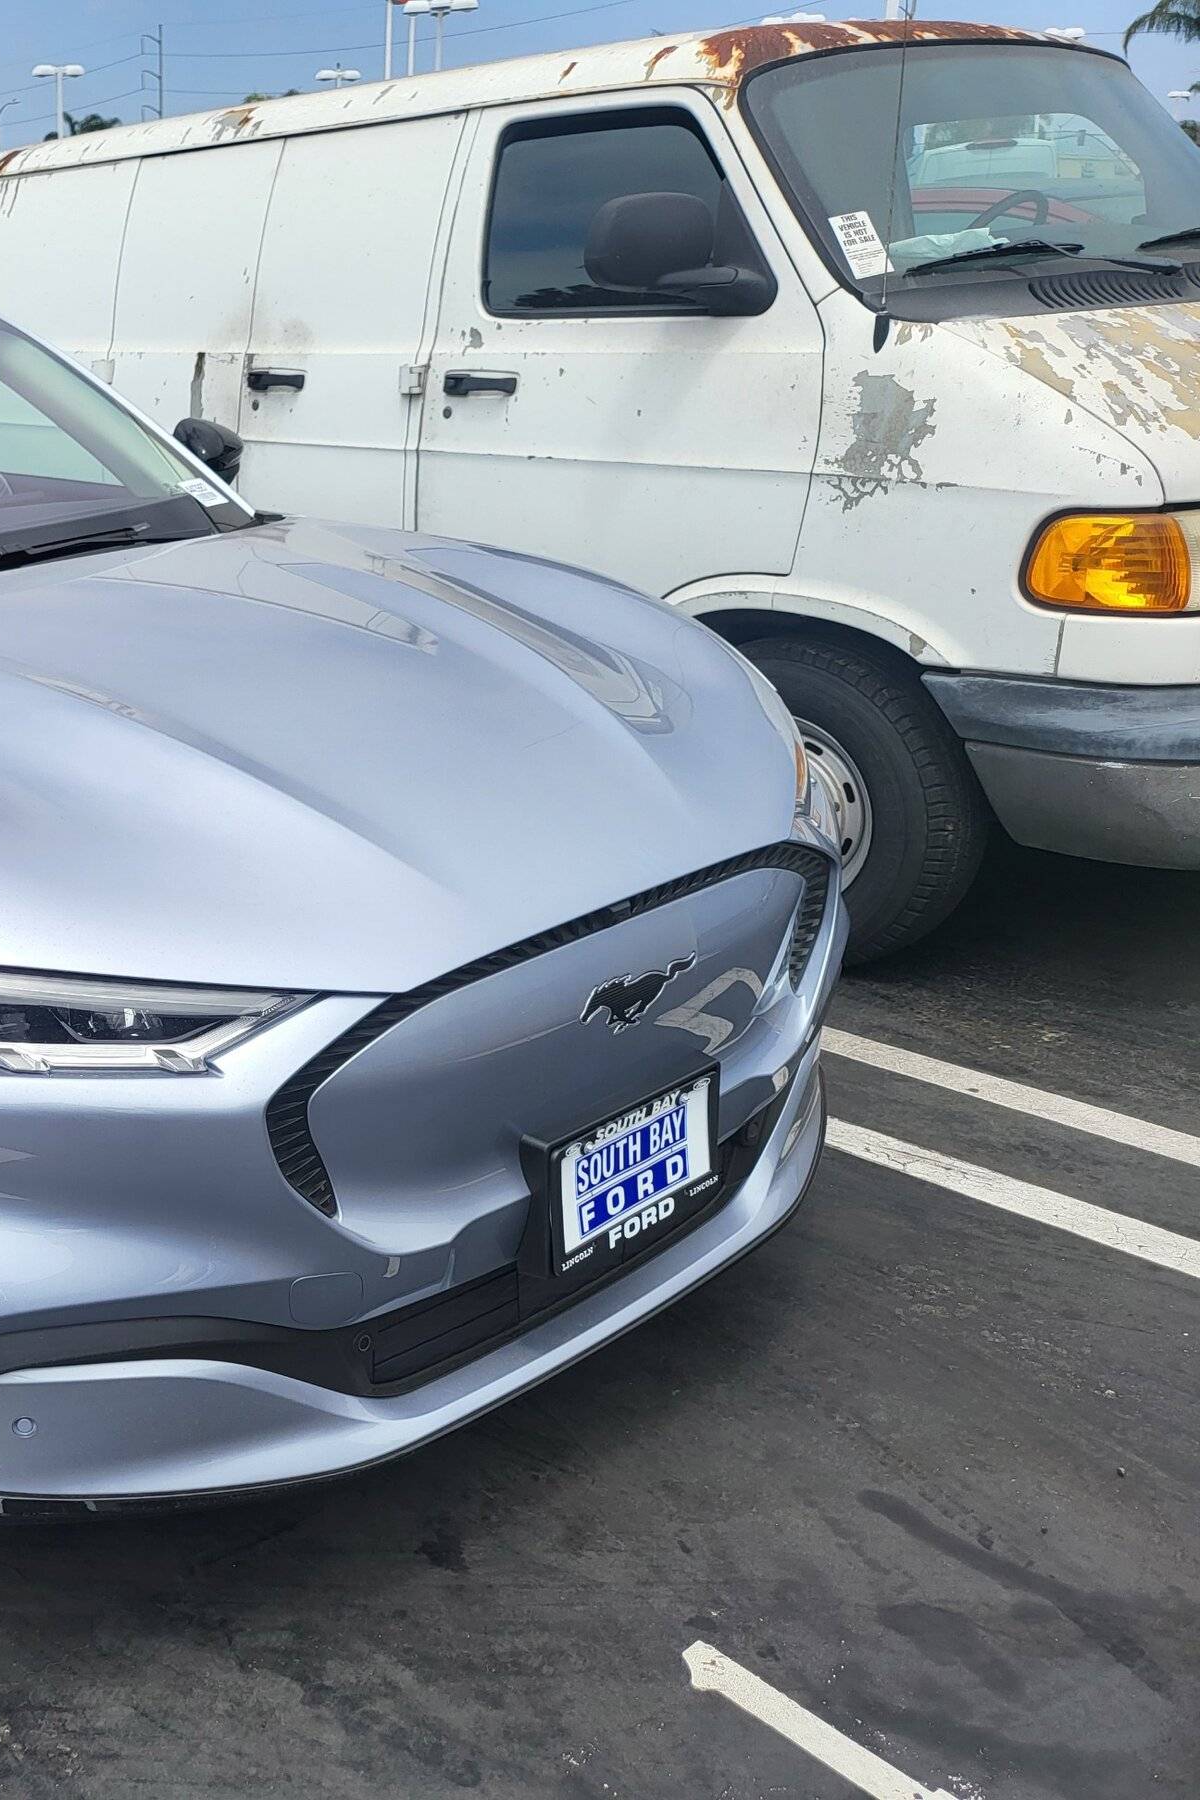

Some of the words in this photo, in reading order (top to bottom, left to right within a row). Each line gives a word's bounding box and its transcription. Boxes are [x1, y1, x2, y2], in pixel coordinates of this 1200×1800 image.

[838, 220, 867, 232] VEHICLE
[840, 214, 858, 223] THIS
[842, 239, 858, 247] FOR
[859, 234, 876, 244] SALE
[844, 231, 853, 239] IS
[853, 228, 868, 237] NOT
[595, 1107, 648, 1142] SOUTH
[651, 1090, 681, 1116] BAY
[577, 1131, 642, 1193] SOUTH
[649, 1108, 684, 1155] BAY
[580, 1154, 685, 1233] FORD
[689, 1175, 719, 1196] LINCOLN
[608, 1197, 675, 1250] FORD
[561, 1247, 594, 1271] LINCOLN
